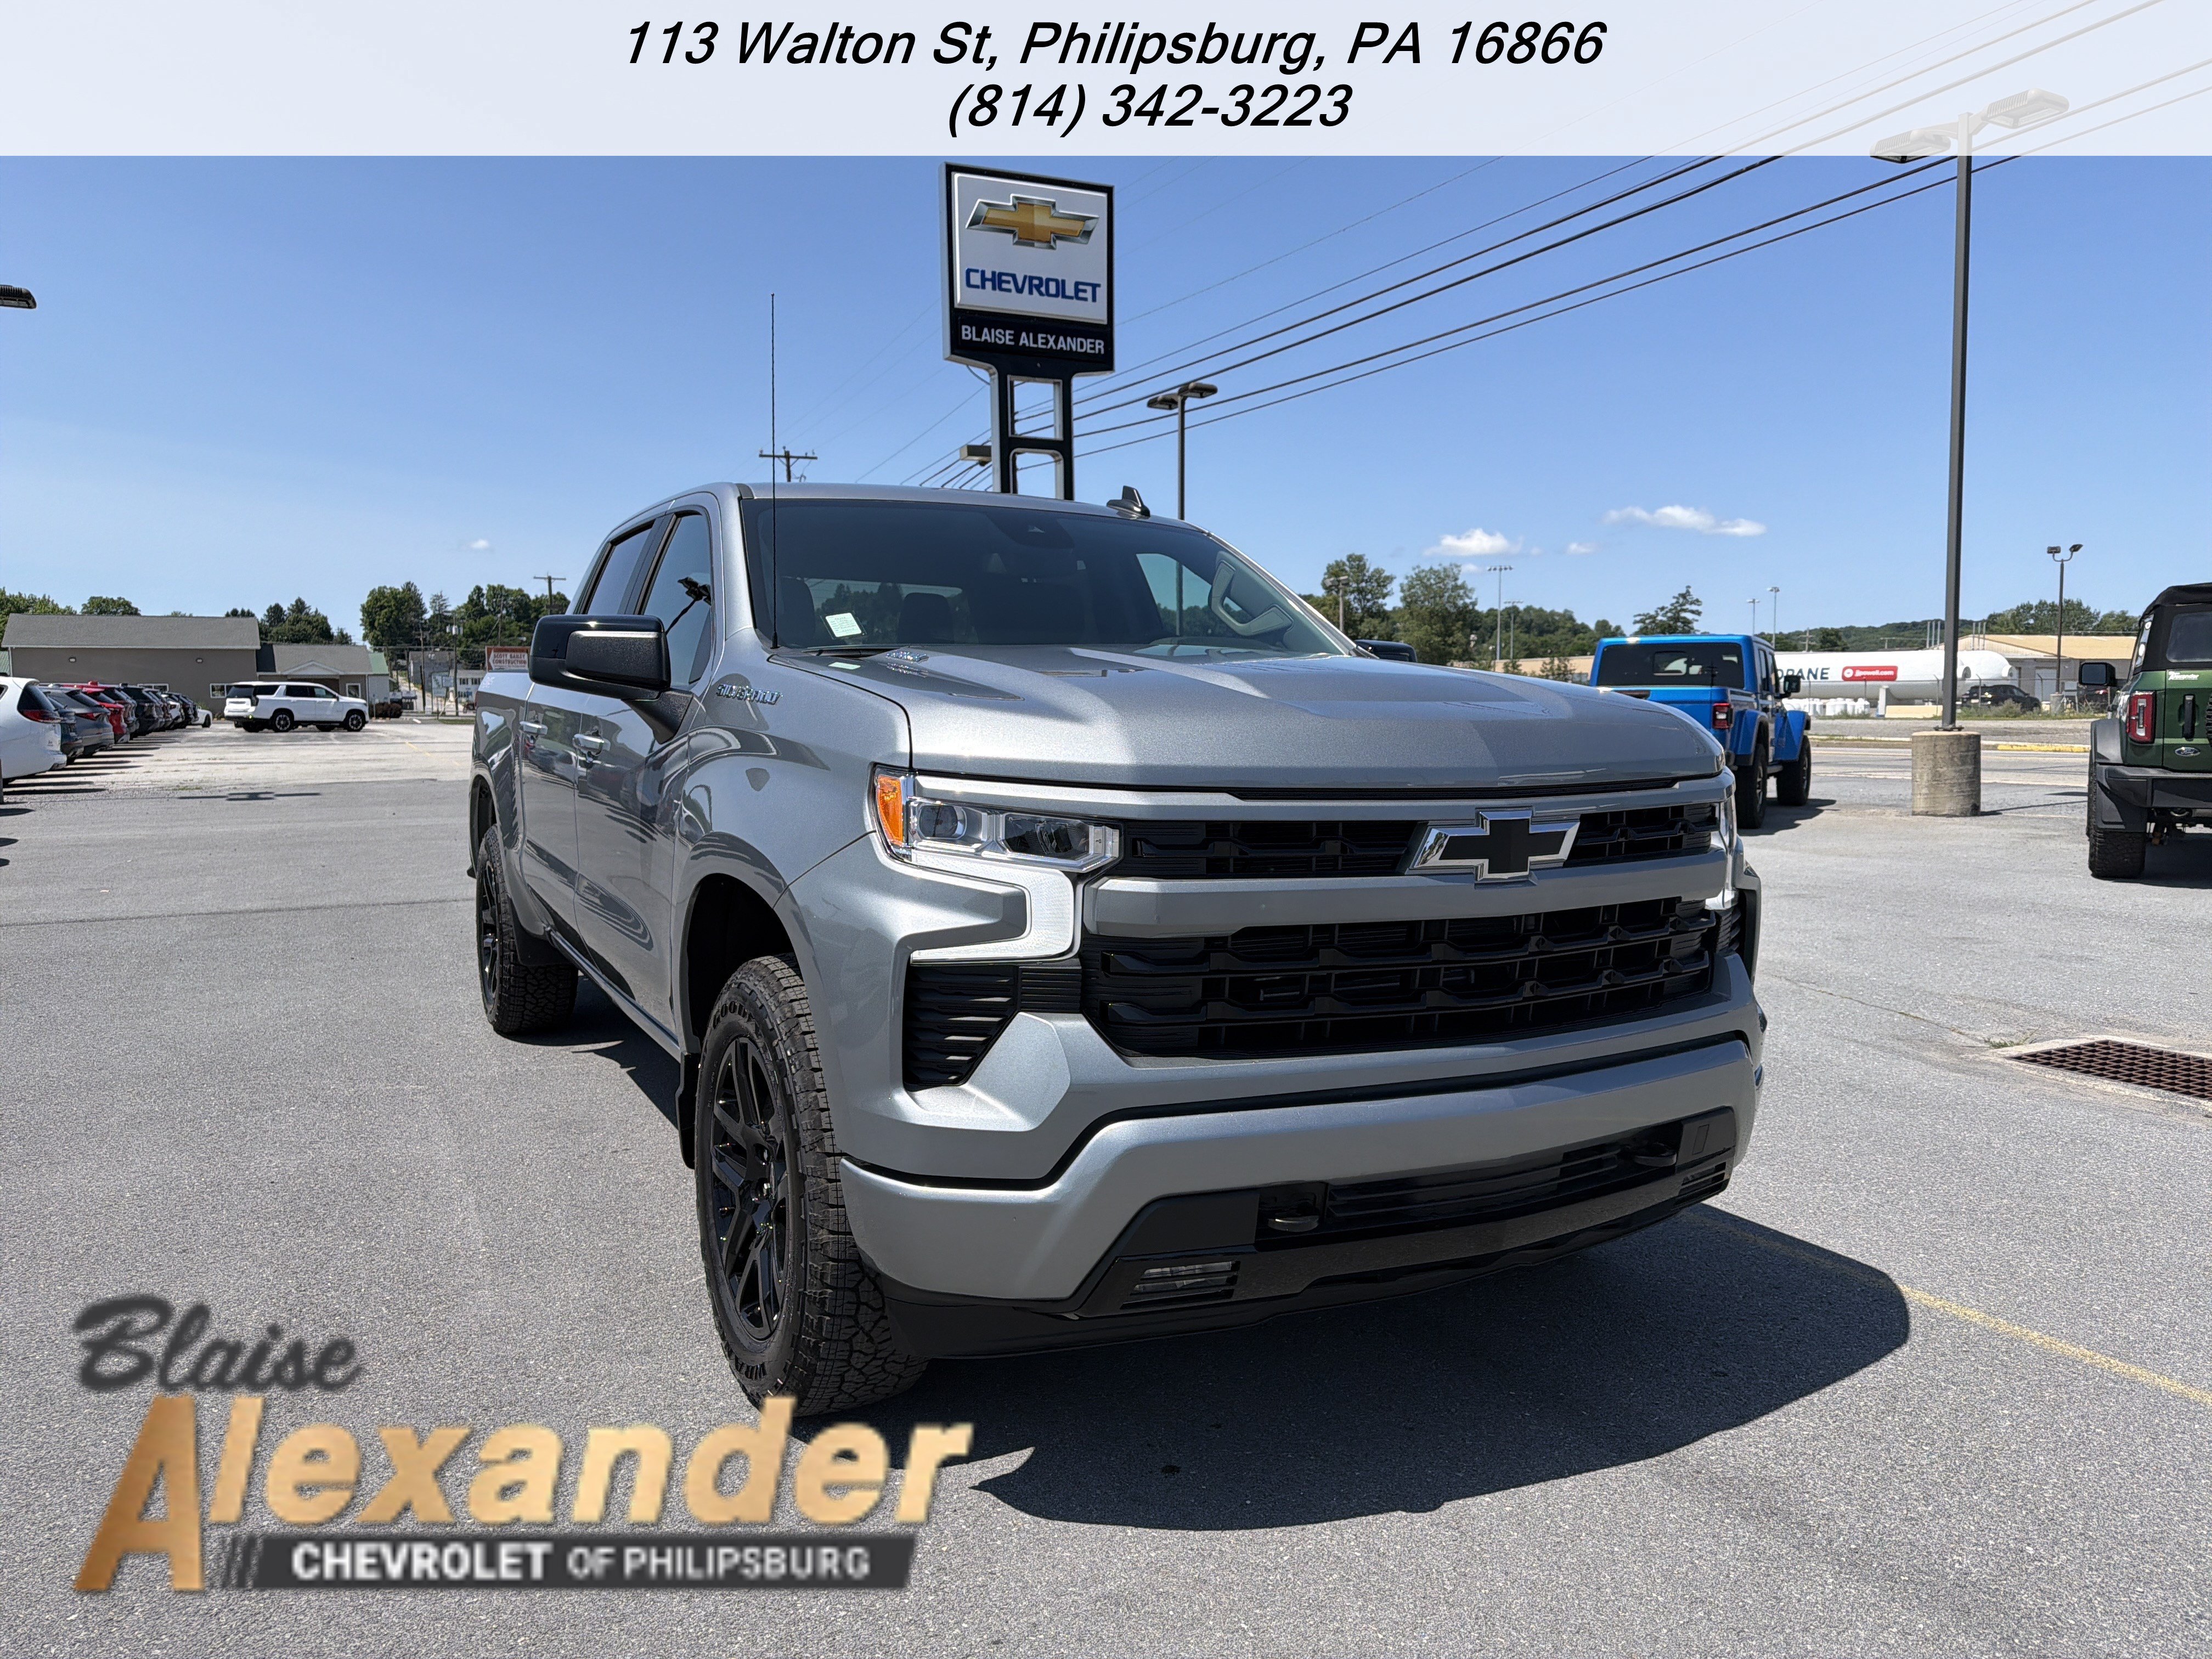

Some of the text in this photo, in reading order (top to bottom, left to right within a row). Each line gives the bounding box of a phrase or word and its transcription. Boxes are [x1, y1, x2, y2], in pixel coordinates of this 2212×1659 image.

[965, 267, 1102, 303] CHEVROLET
[961, 325, 1105, 355] BLAISE ALEXANDER
